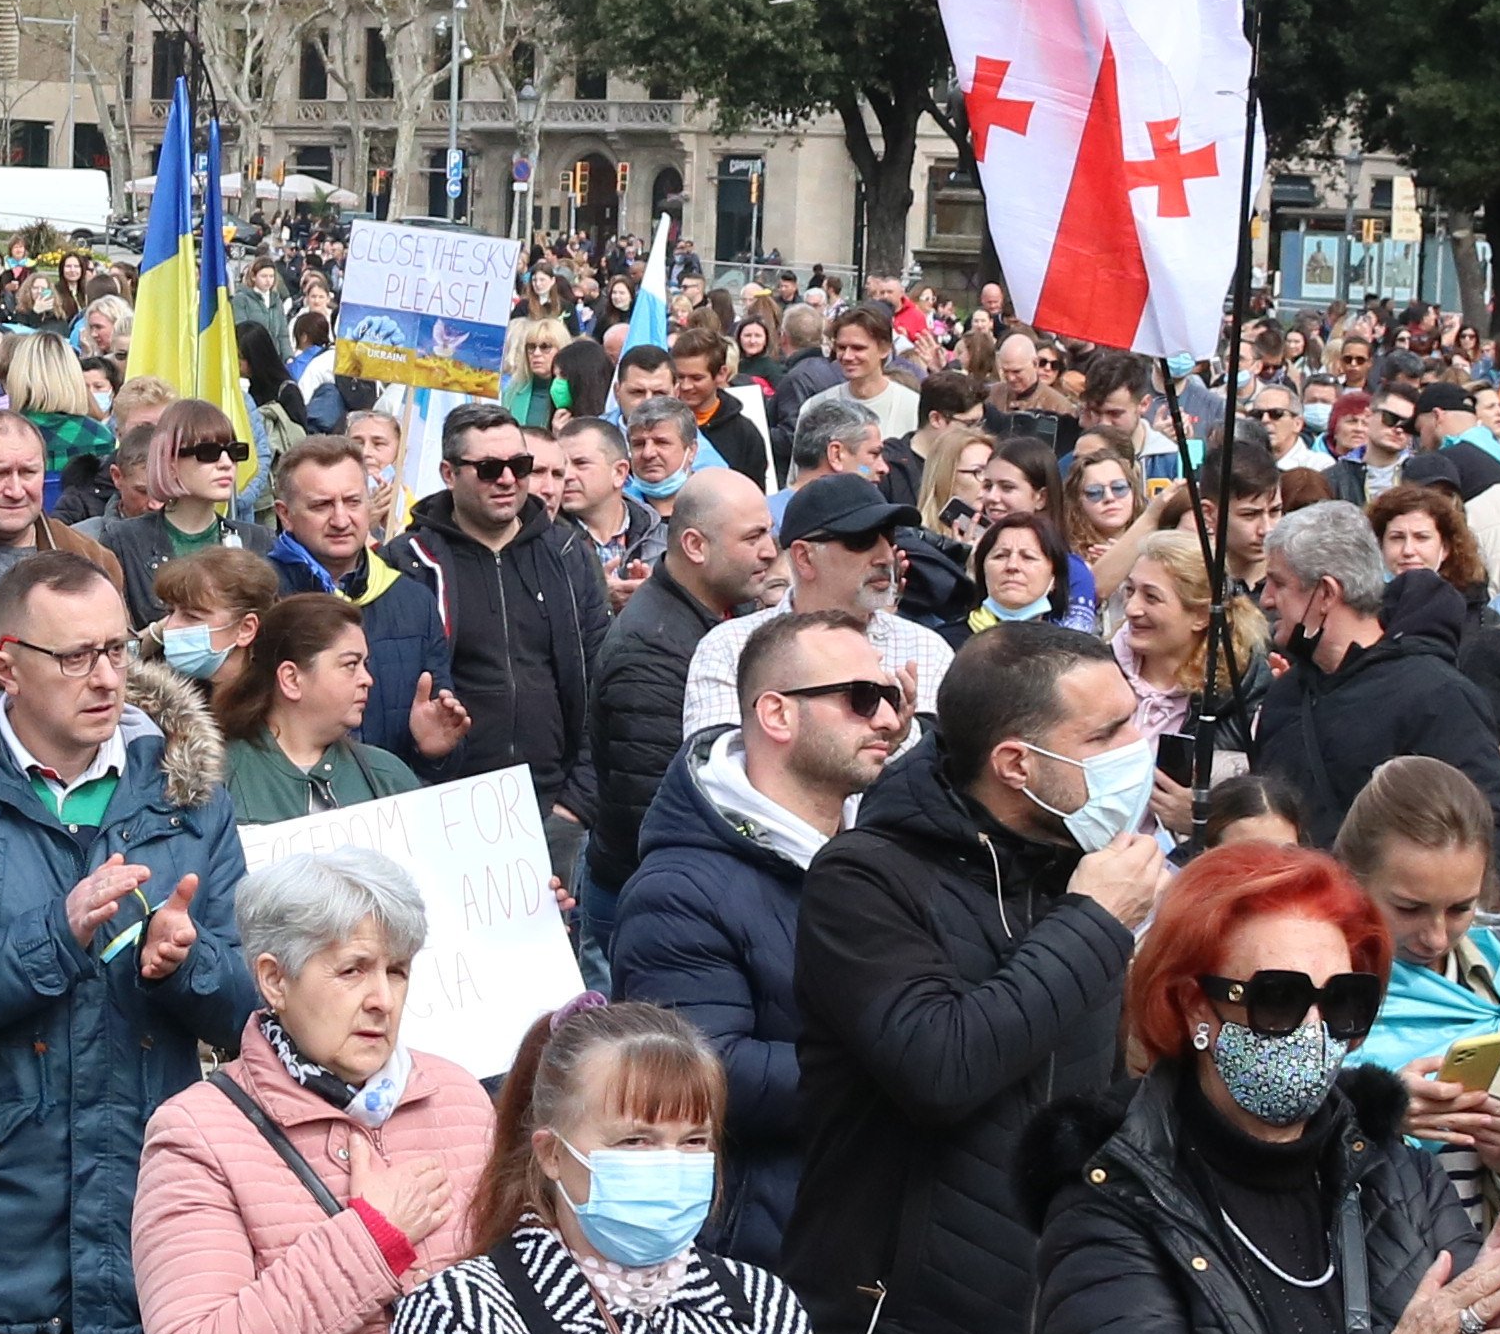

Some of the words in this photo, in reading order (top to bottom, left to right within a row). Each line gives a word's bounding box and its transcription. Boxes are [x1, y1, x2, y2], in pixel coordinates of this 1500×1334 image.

[350, 228, 429, 269] CLOSE
[430, 236, 468, 273] THE
[469, 242, 517, 280] SKY
[384, 273, 490, 321] PLEASE!
[439, 773, 537, 851] FOR
[463, 858, 540, 931] AND
